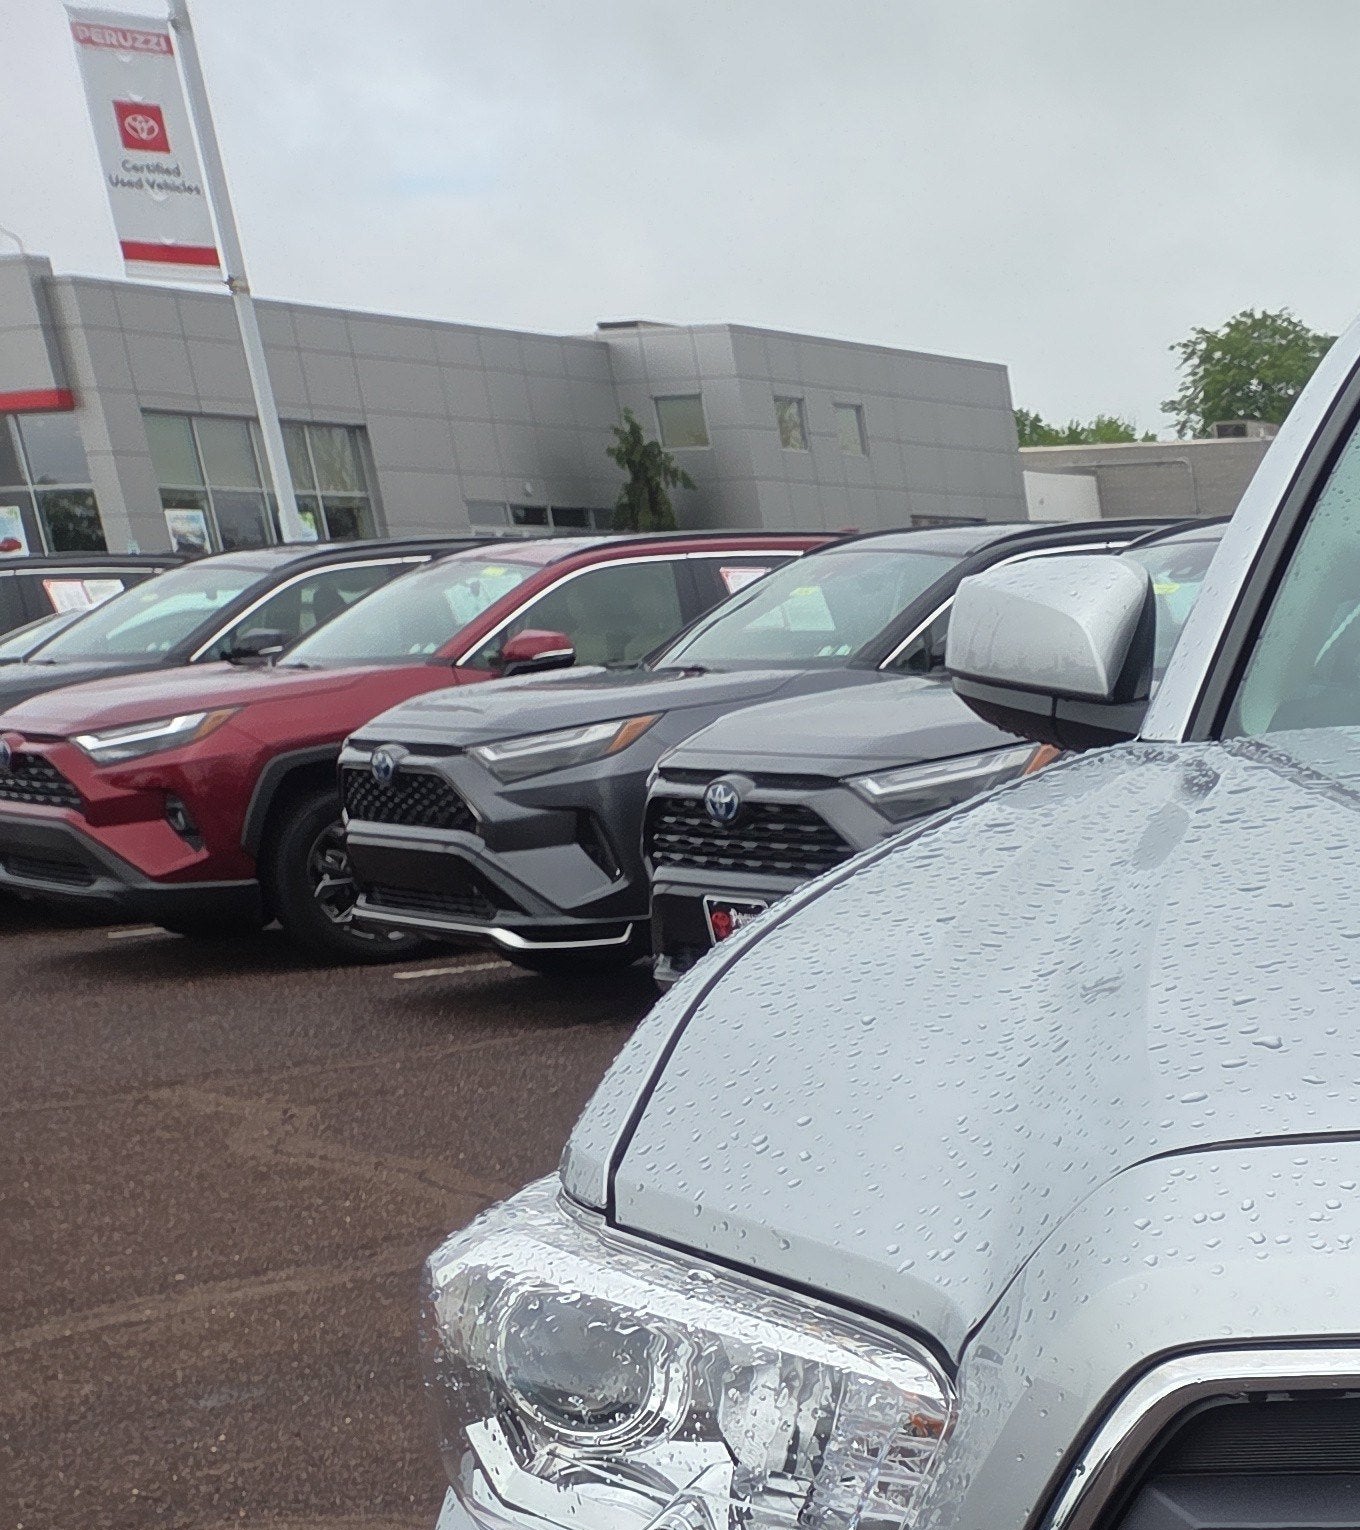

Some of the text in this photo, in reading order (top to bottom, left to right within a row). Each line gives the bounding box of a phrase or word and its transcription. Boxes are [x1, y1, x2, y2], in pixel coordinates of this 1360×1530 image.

[76, 25, 168, 51] PERUZZI
[121, 159, 181, 177] Certified
[108, 174, 200, 195] Used Vehicles
